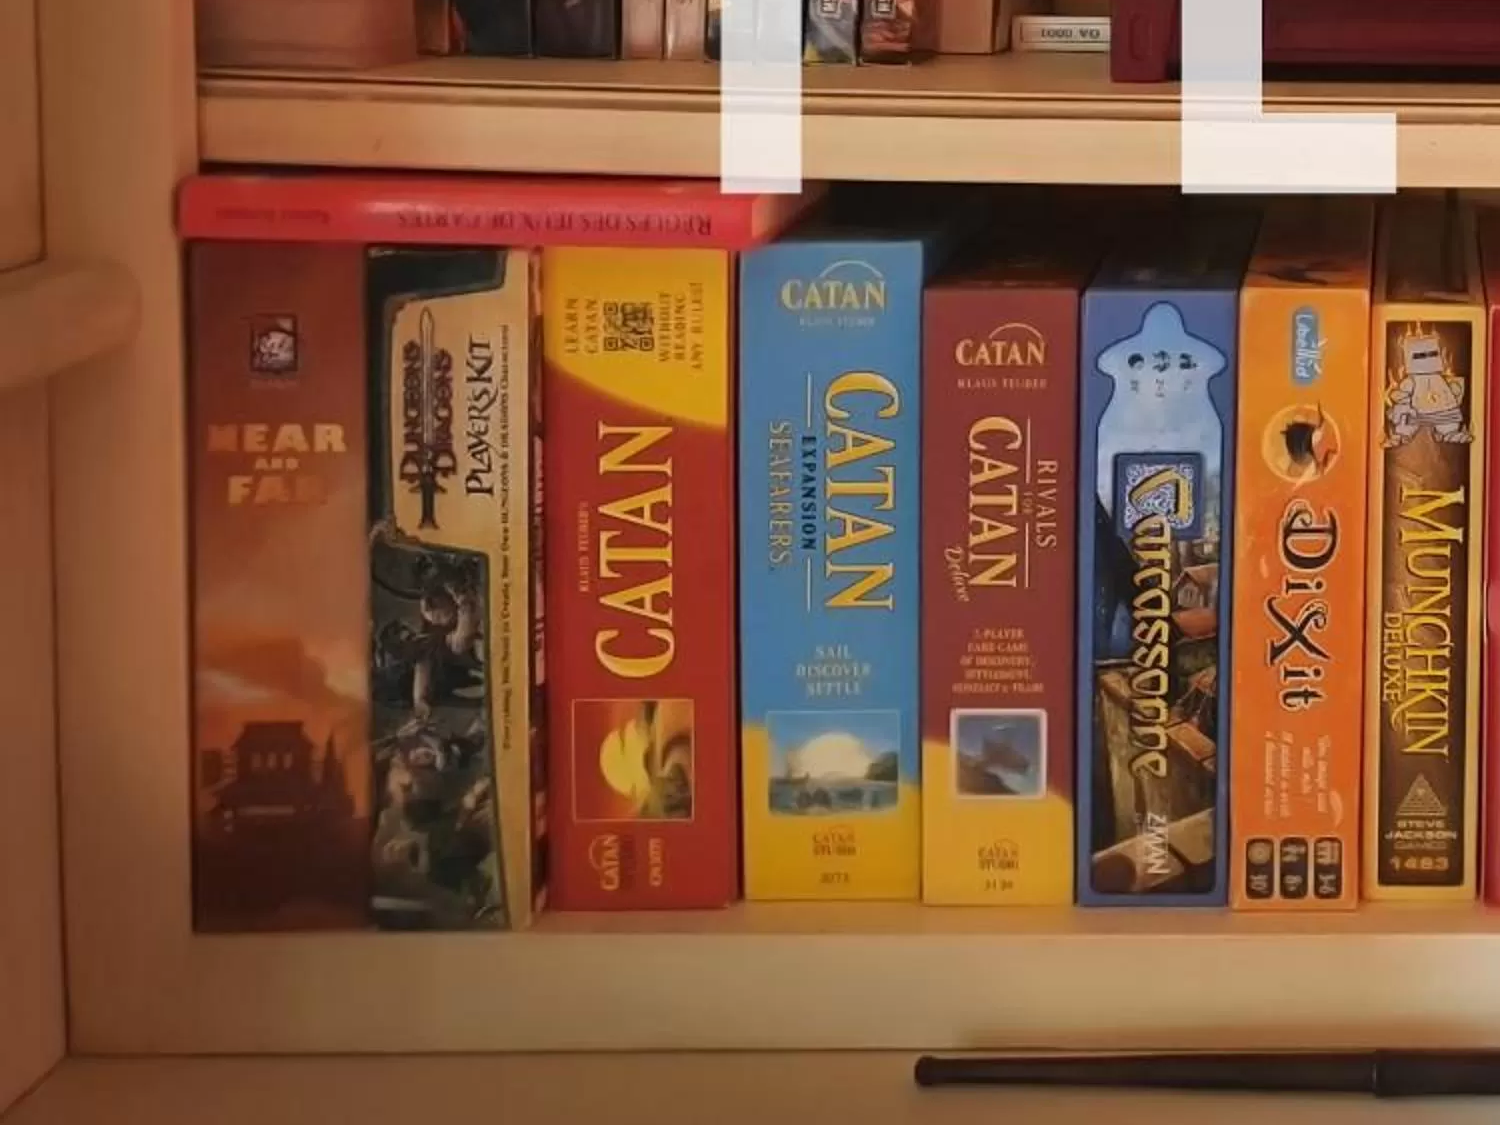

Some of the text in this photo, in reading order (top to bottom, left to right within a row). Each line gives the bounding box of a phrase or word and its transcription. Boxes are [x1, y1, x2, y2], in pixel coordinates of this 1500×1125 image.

[780, 278, 887, 311] CATAN
[955, 338, 1046, 367] CATAN
[400, 340, 421, 489] DUNGEONS
[432, 348, 458, 490] DRAGONS
[464, 333, 498, 497] PLAYER'S KIT
[768, 422, 793, 565] SEAFARERS
[800, 435, 818, 551] EXPANSION
[823, 370, 900, 611] CATAN
[968, 415, 1023, 588] CATAN
[1034, 459, 1058, 549] RIVALS
[595, 421, 675, 678] CATAN
[795, 663, 871, 677] DISCOVER
[815, 644, 852, 660] SAIL
[1128, 465, 1194, 778] Carcassonne
[1382, 612, 1401, 702] DELUXE
[1392, 485, 1465, 763] MUNCHKIN
[806, 681, 862, 696] SETTLE
[601, 834, 621, 892] CATAN
[1384, 830, 1457, 840] JACKSON
